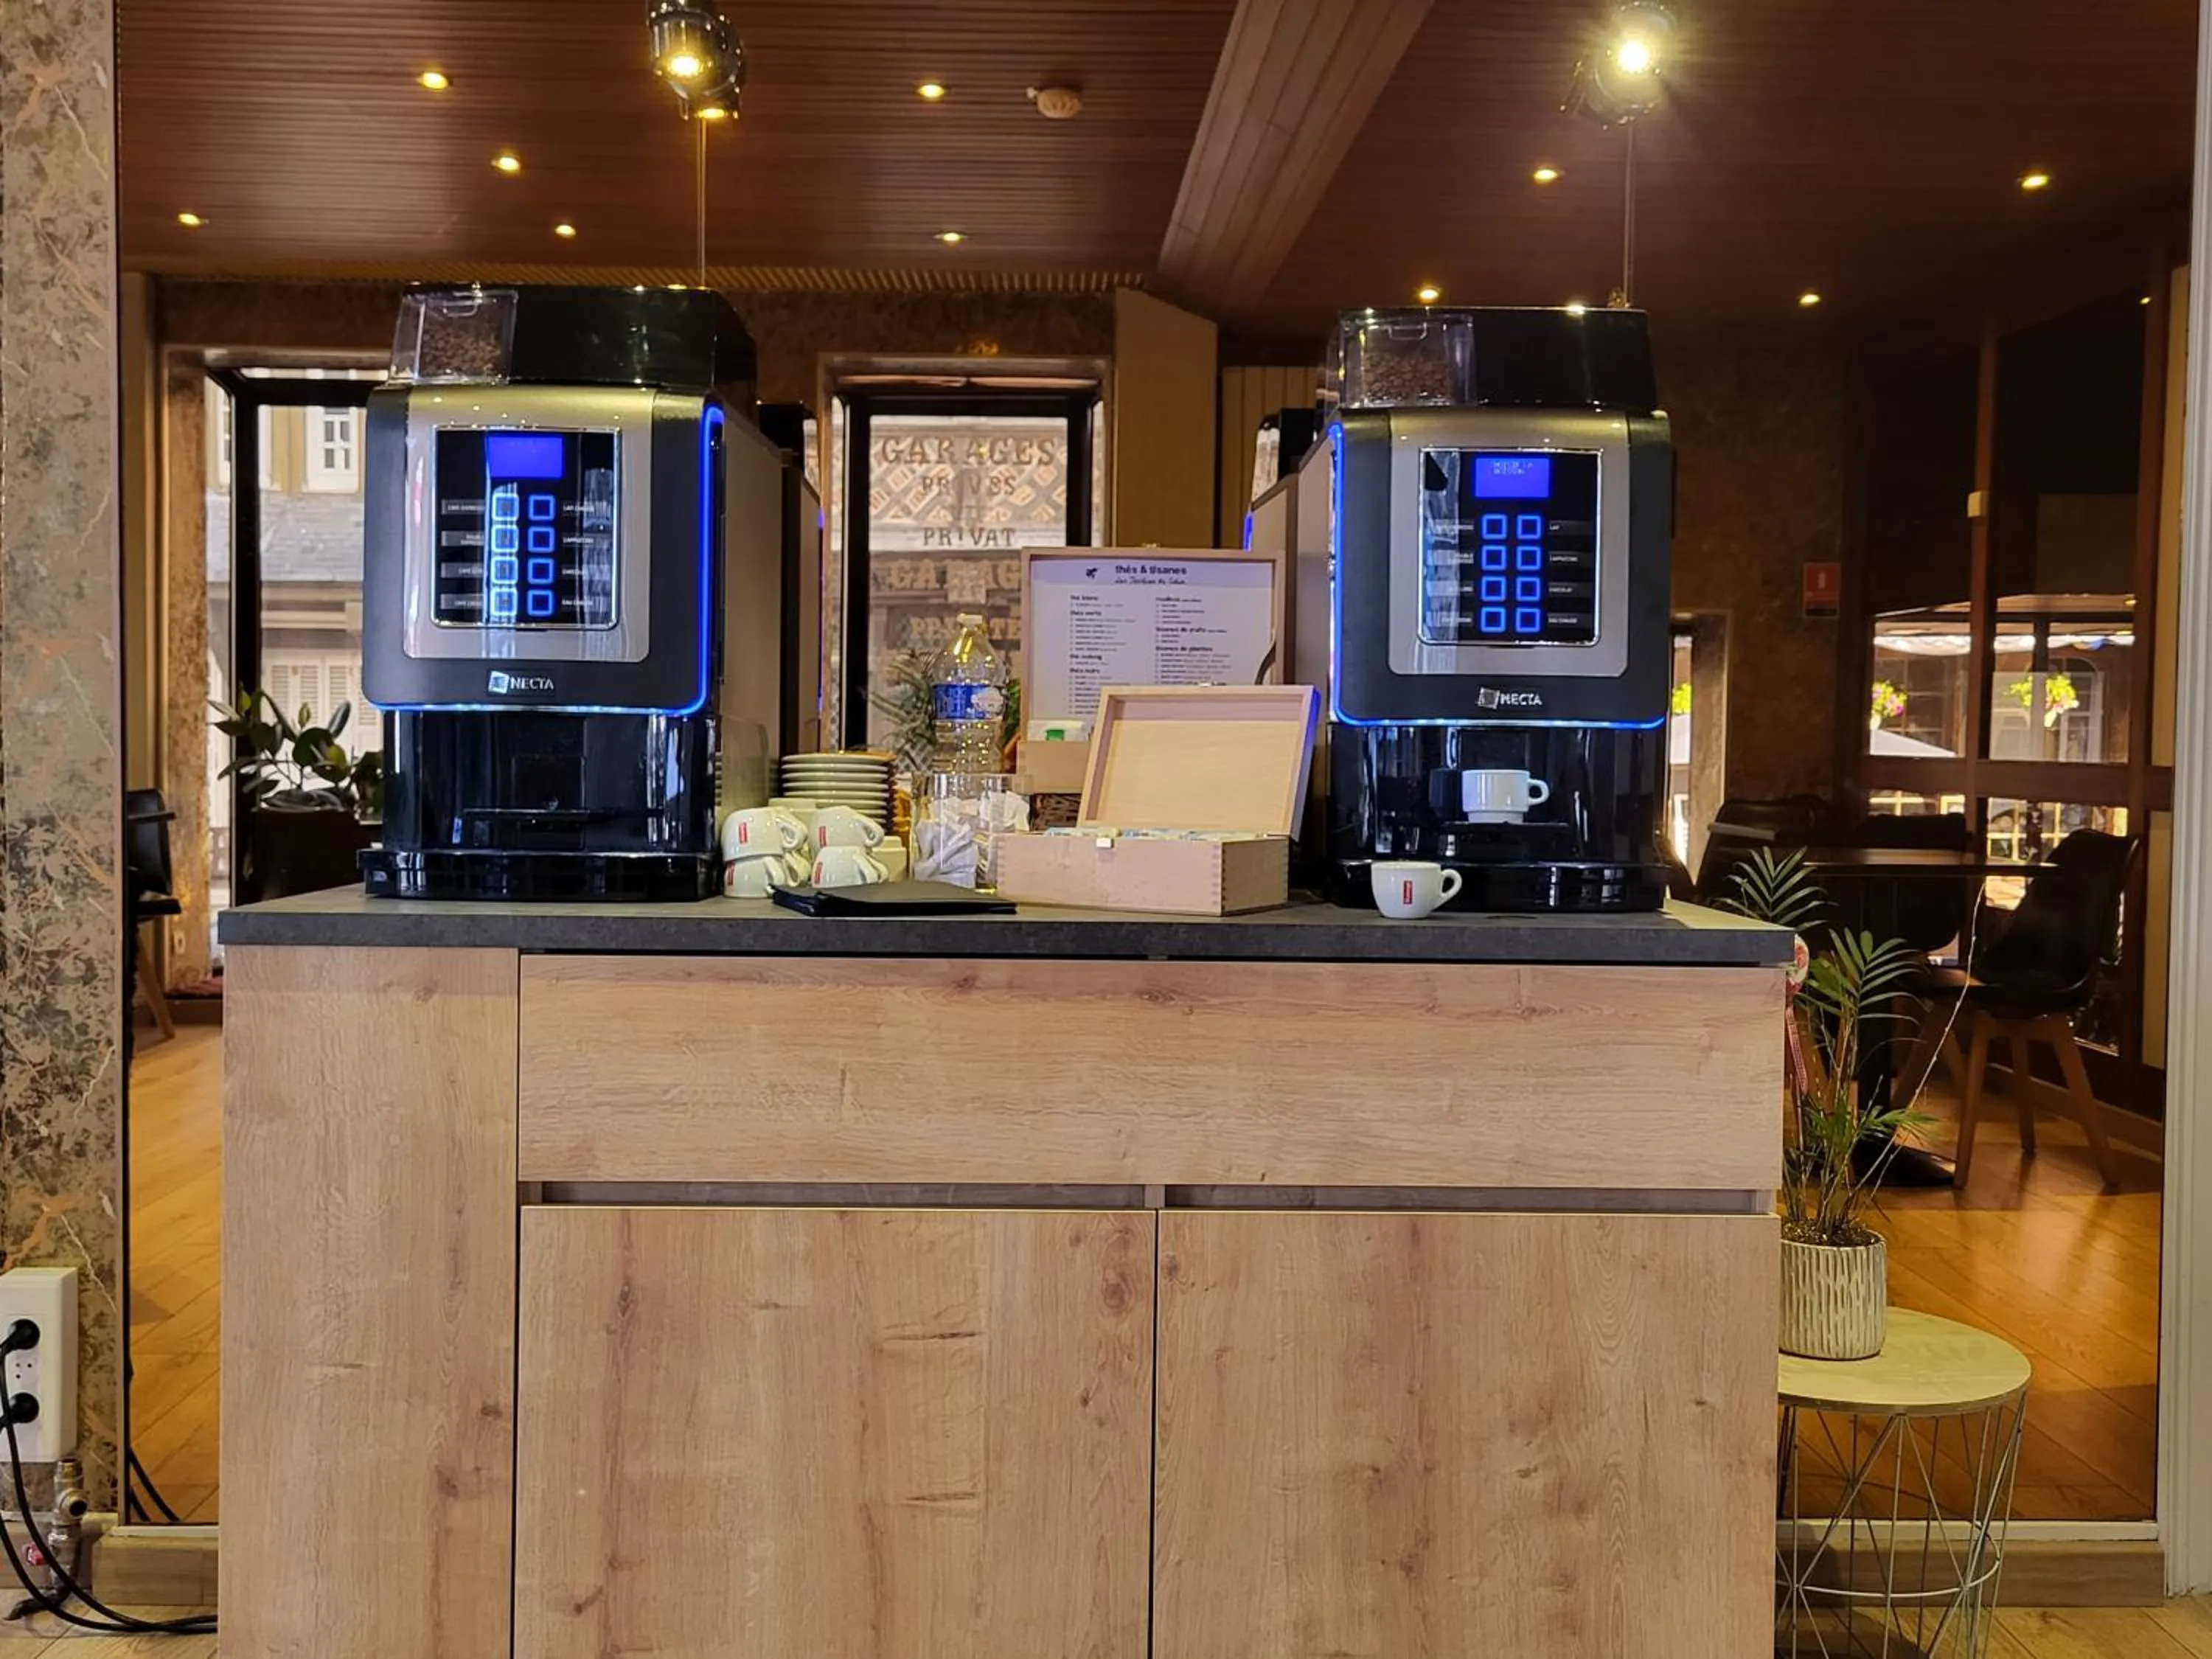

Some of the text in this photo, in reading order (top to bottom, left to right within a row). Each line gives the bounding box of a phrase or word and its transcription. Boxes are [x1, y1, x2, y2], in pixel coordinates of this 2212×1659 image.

[923, 527, 1015, 546] PRIVAT
[509, 676, 555, 690] NECTA
[1500, 692, 1543, 706] NECTA
